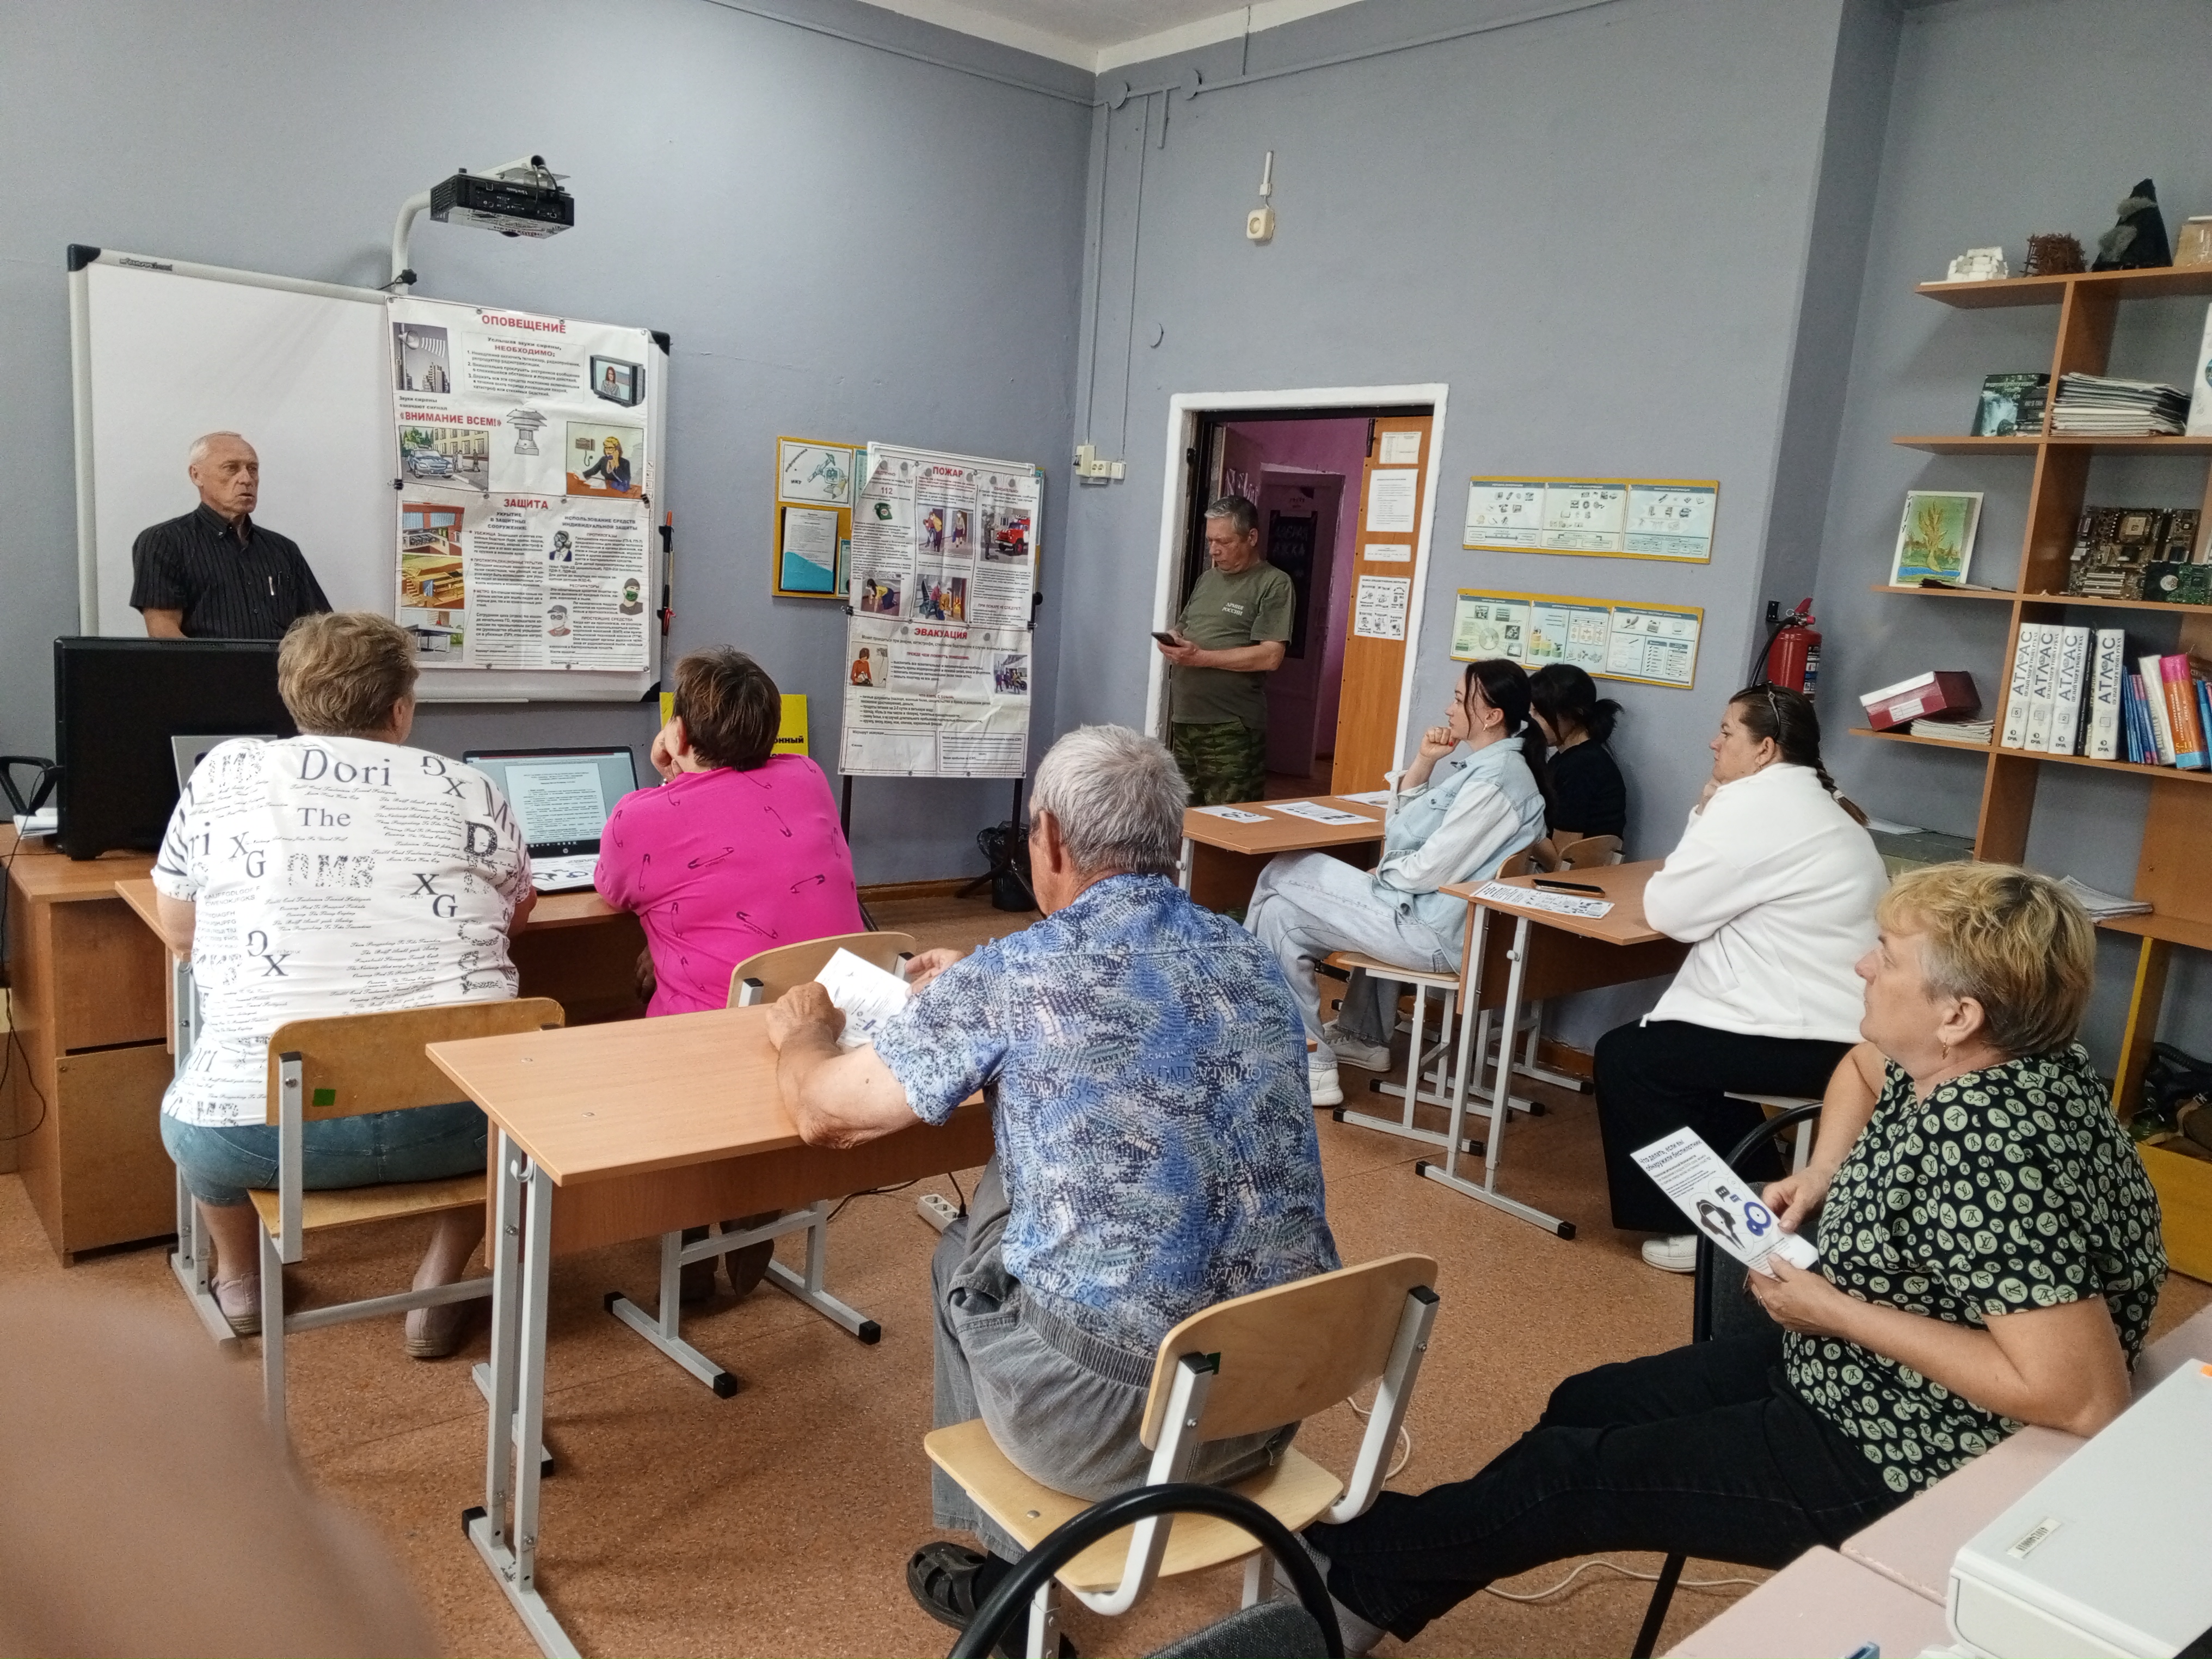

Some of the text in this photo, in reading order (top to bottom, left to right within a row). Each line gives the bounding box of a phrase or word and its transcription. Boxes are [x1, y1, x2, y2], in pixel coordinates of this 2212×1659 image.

[482, 315, 567, 334] ОПОВЕЩЕНИЕ
[495, 345, 555, 357] НЕОБХОДИМО:
[400, 411, 501, 427] «ВНИМАНИЕ ВСЕМ!»
[932, 466, 963, 478] ПОЖАР
[503, 498, 549, 509] ЗАЩИТА
[1222, 606, 1243, 616] РОССИИ
[1226, 602, 1244, 610] АРМИЯ
[914, 627, 967, 640] ЭВАКУАЦИЯ
[2012, 631, 2032, 696] АТЛАС
[2034, 633, 2053, 698] АТЛАС
[2059, 636, 2077, 701] АТЛАС
[2098, 637, 2116, 704] АТЛАС
[297, 748, 392, 787] Dori
[297, 808, 351, 827] The
[1665, 1144, 1678, 1152] если
